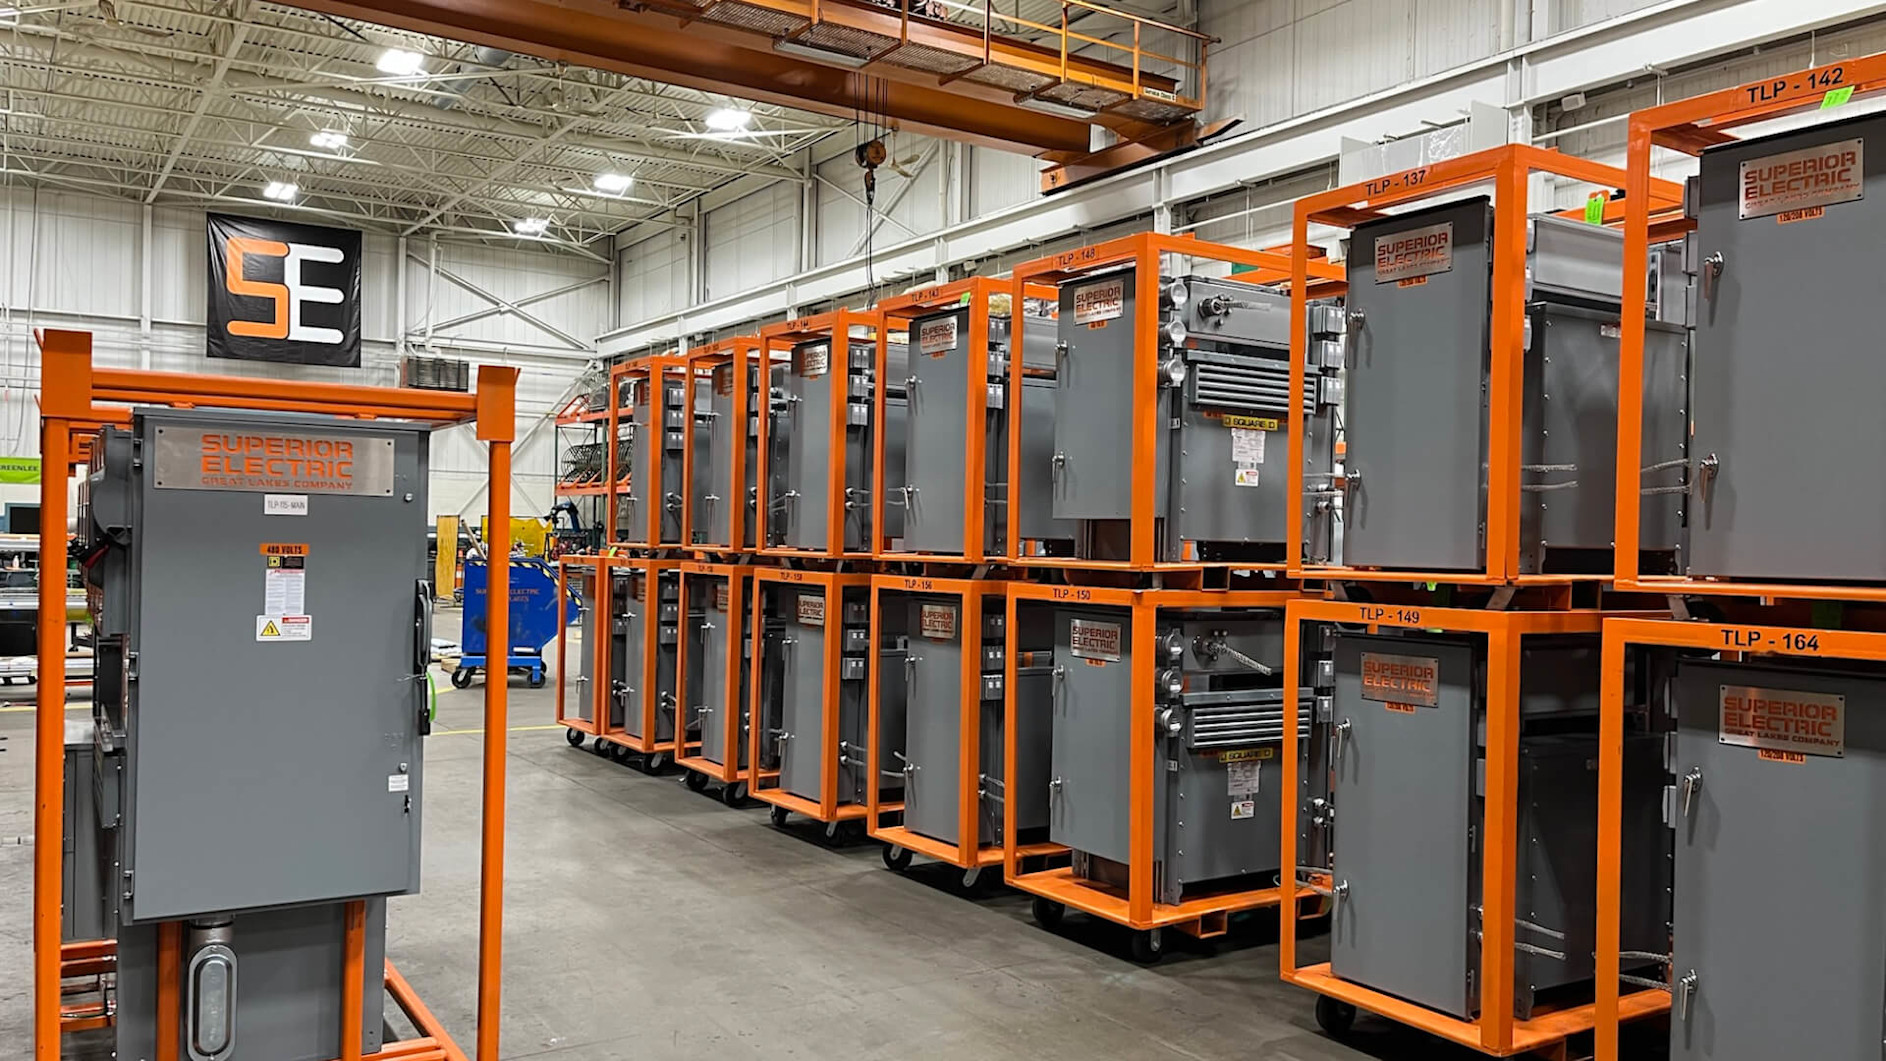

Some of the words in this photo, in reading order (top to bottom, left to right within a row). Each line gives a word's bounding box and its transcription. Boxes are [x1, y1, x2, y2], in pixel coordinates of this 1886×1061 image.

[1747, 81, 1786, 103] TLP
[1808, 68, 1843, 89] 142
[1745, 150, 1856, 185] SUPERIOR
[1366, 179, 1390, 196] TLP
[1403, 170, 1426, 187] 137
[1745, 168, 1851, 200] ELECTRIC
[1377, 232, 1448, 256] SUPERIOR
[1058, 253, 1074, 266] TLP
[1081, 248, 1095, 260] 148
[1377, 245, 1445, 268] ELECTRIC
[1076, 286, 1121, 303] SUPERIOR
[1076, 298, 1118, 313] ELECTRIC
[921, 322, 955, 336] SUPERIOR
[1233, 417, 1265, 428] SQUARE
[202, 433, 353, 458] SUPERIOR
[202, 455, 353, 479] ELECTRIC
[202, 476, 243, 486] GREAT
[249, 478, 289, 488] LAKES
[293, 480, 353, 490] COMPANY
[267, 545, 279, 554] 480
[281, 545, 302, 554] VOLTS
[905, 579, 916, 588] TLP
[1053, 588, 1068, 599] TLP
[1077, 590, 1090, 600] 150
[1360, 607, 1384, 620] TLP
[1397, 610, 1420, 623] 149
[1072, 626, 1118, 640] SUPERIOR
[1720, 629, 1761, 647] TLP
[1782, 633, 1819, 651] 164
[1072, 636, 1115, 650] ELECTRIC
[1364, 661, 1434, 679] SUPERIOR
[1364, 674, 1431, 692] ELECTRIC
[1724, 696, 1838, 721] SUPERIOR
[1724, 712, 1832, 737] ELECTRIC
[1724, 727, 1755, 737] GREAT
[1757, 731, 1789, 741] LAKES
[1791, 734, 1839, 747] COMPANY
